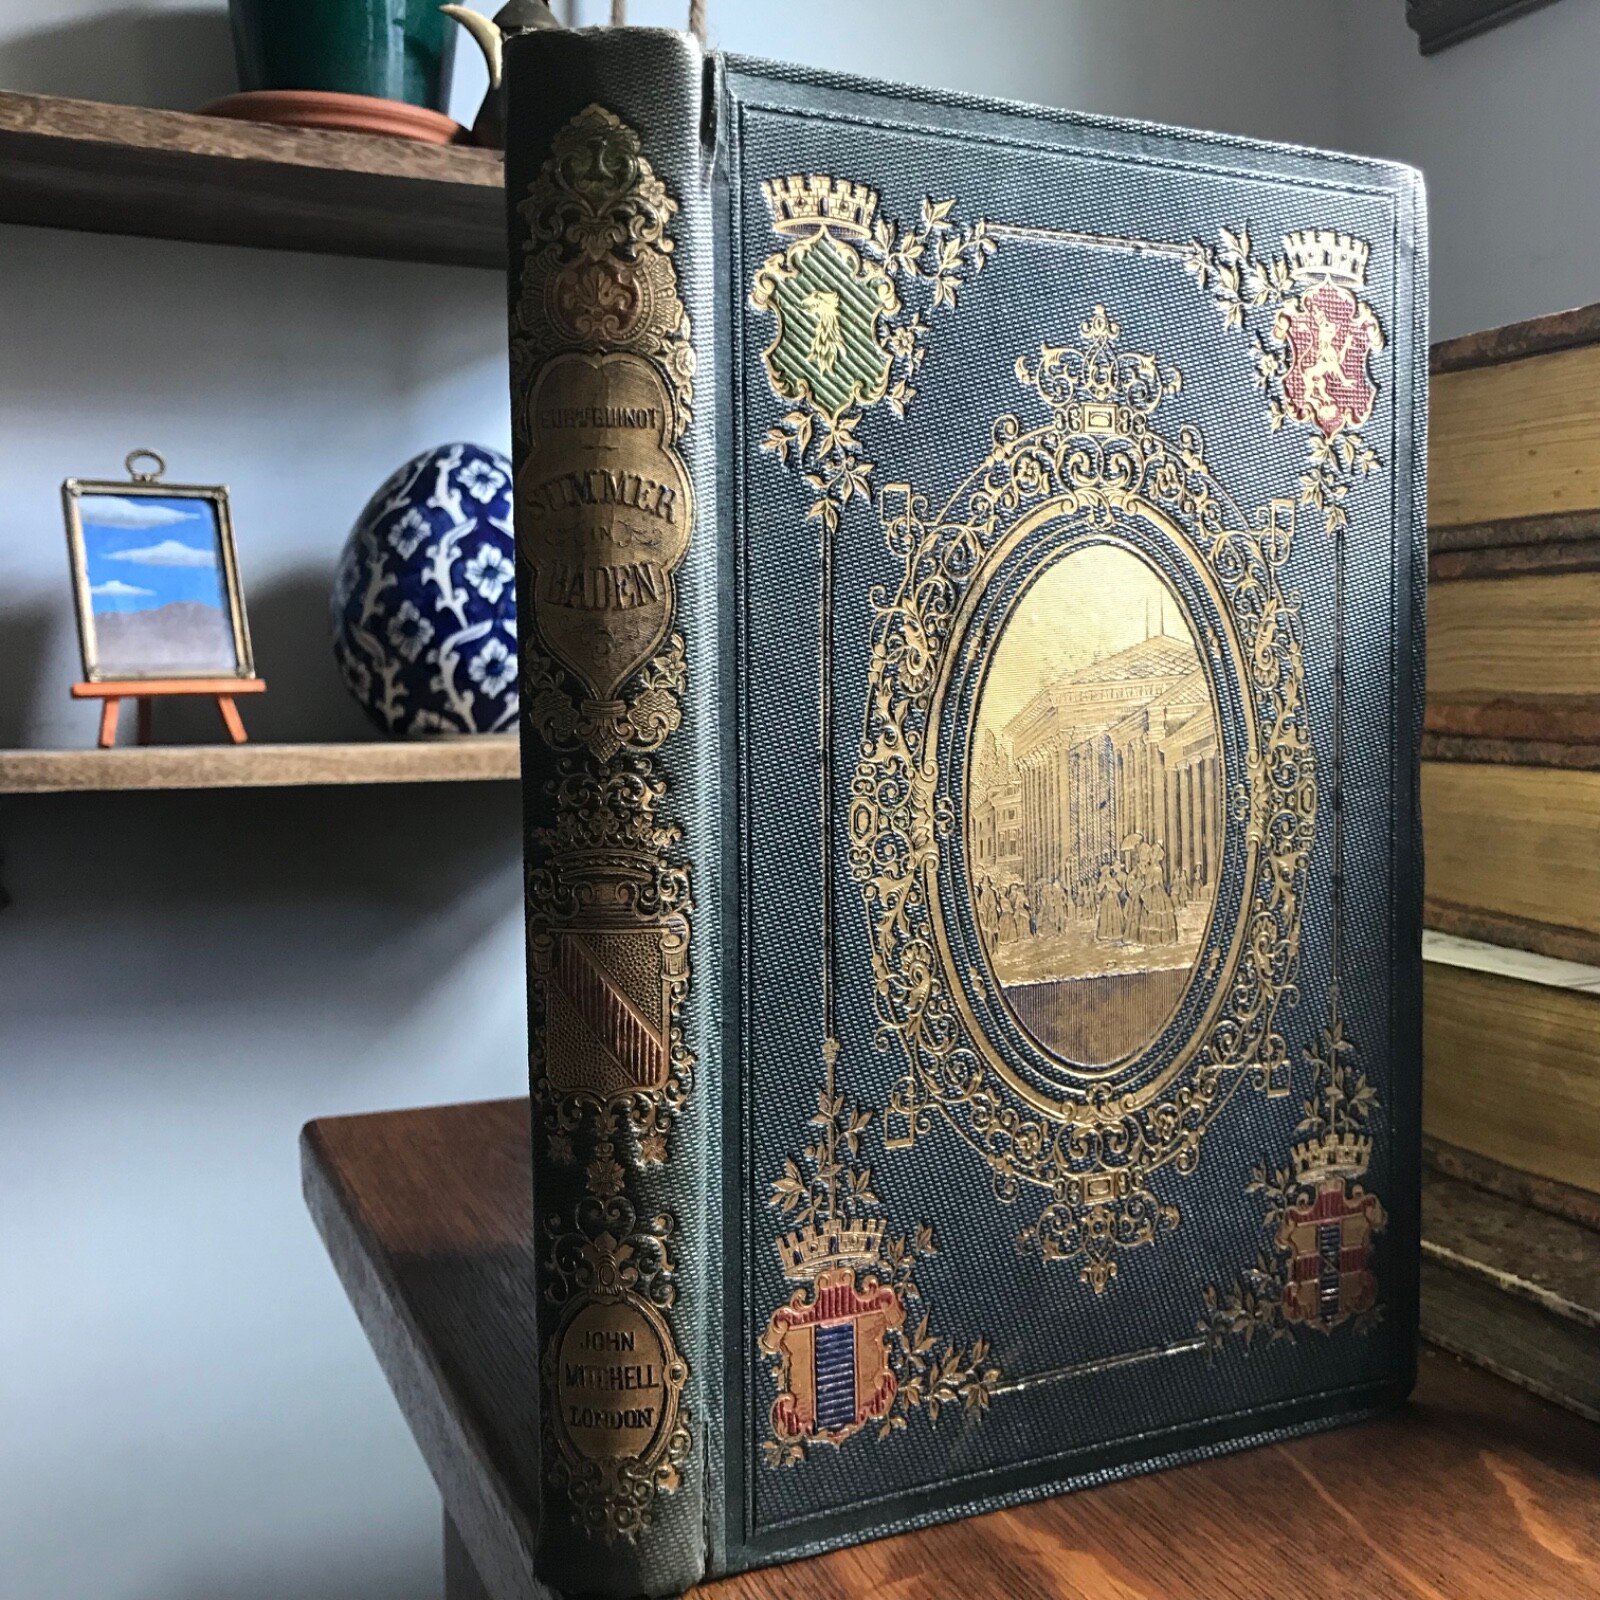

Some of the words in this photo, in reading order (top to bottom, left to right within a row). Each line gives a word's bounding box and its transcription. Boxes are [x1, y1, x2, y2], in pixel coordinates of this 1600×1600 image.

[525, 468, 676, 525] SUMMER
[580, 1331, 635, 1351] JOHN
[566, 1363, 660, 1390] MITCHELL
[570, 1405, 655, 1430] LONDON
